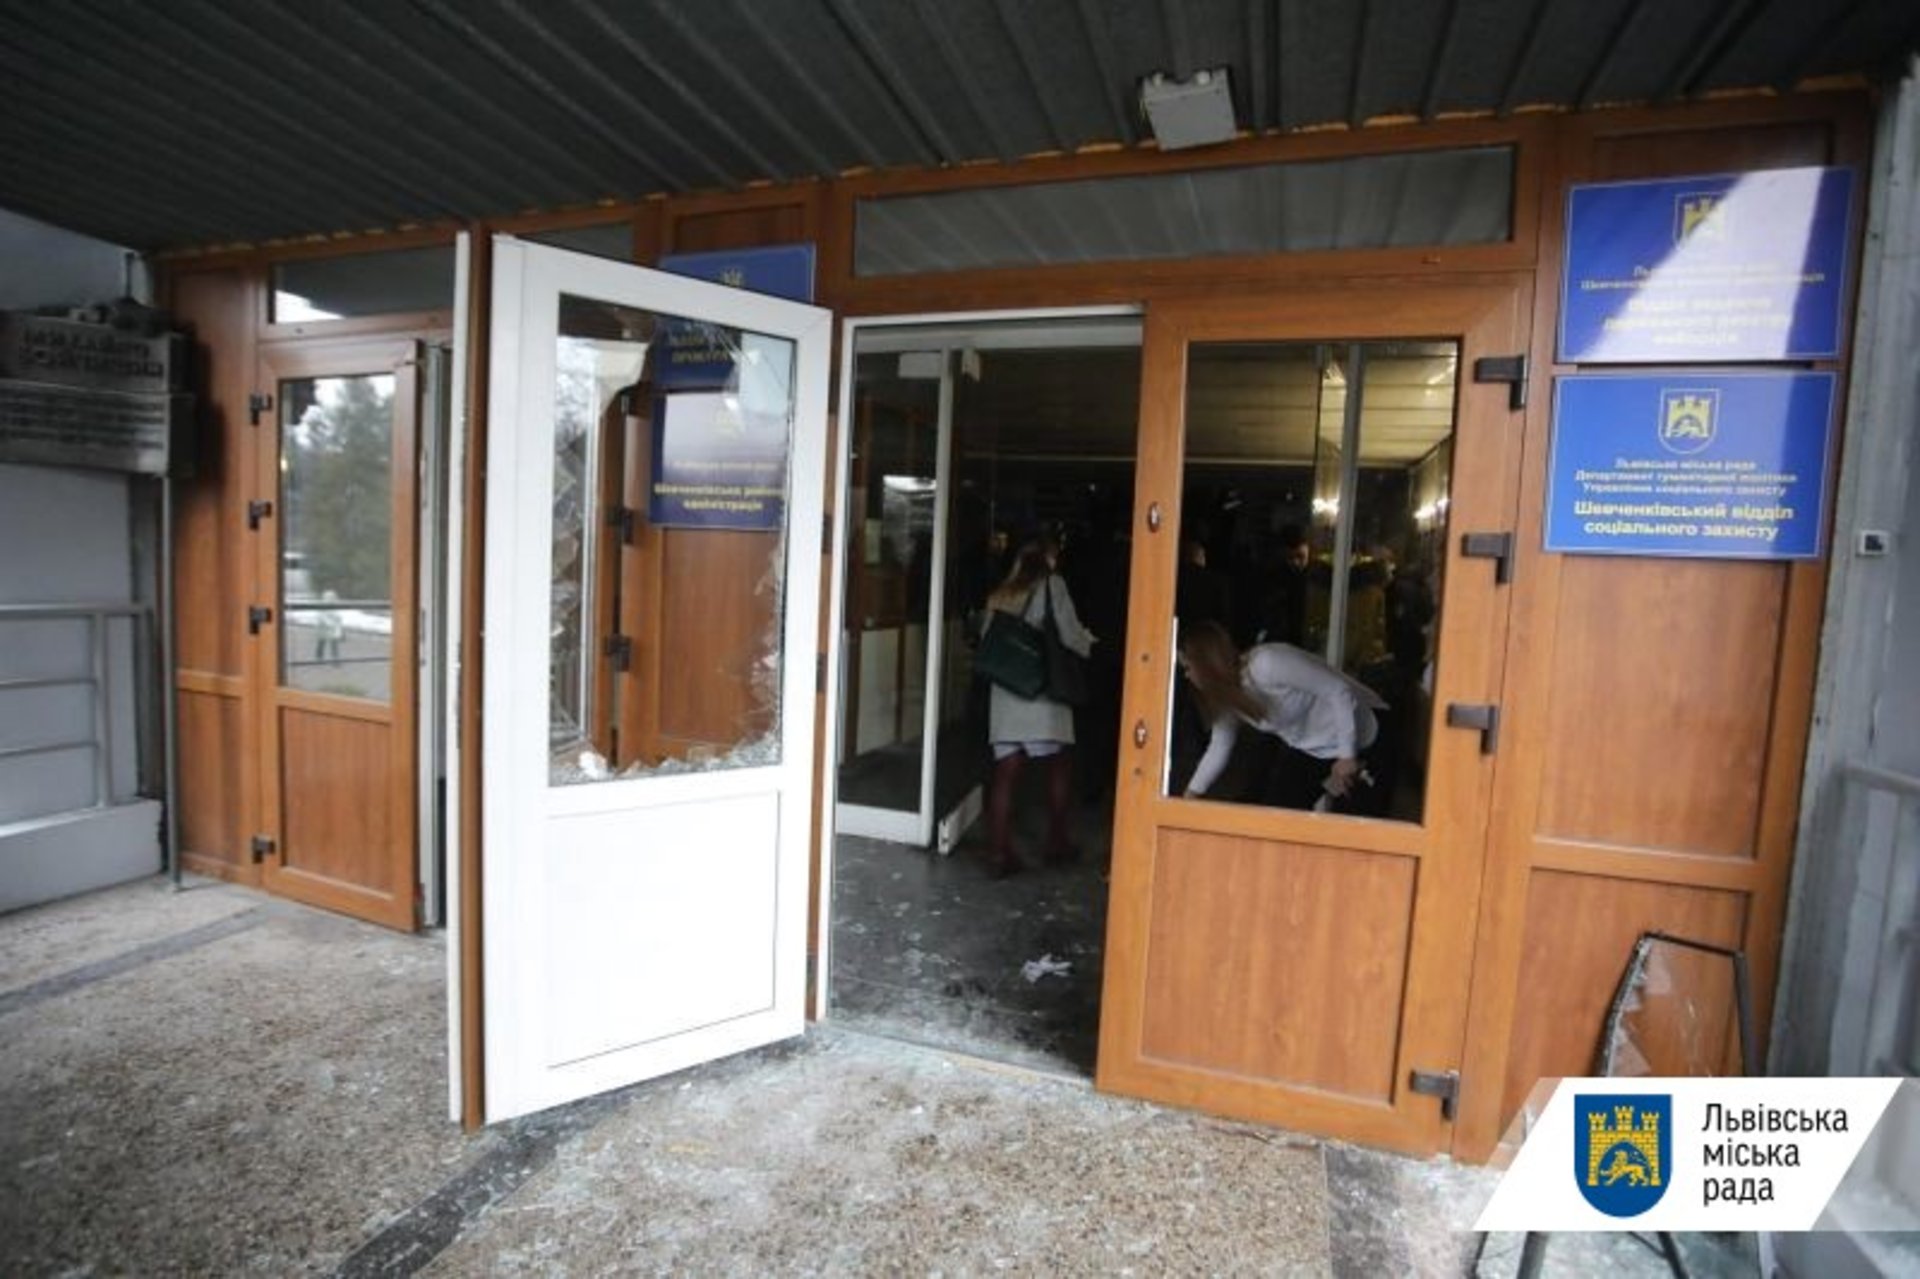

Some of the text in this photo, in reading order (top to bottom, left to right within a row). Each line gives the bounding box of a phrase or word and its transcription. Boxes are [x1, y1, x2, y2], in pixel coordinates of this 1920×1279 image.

[1574, 501, 1794, 522] Шевченківський відділ
[1584, 521, 1779, 542] соціального захисту
